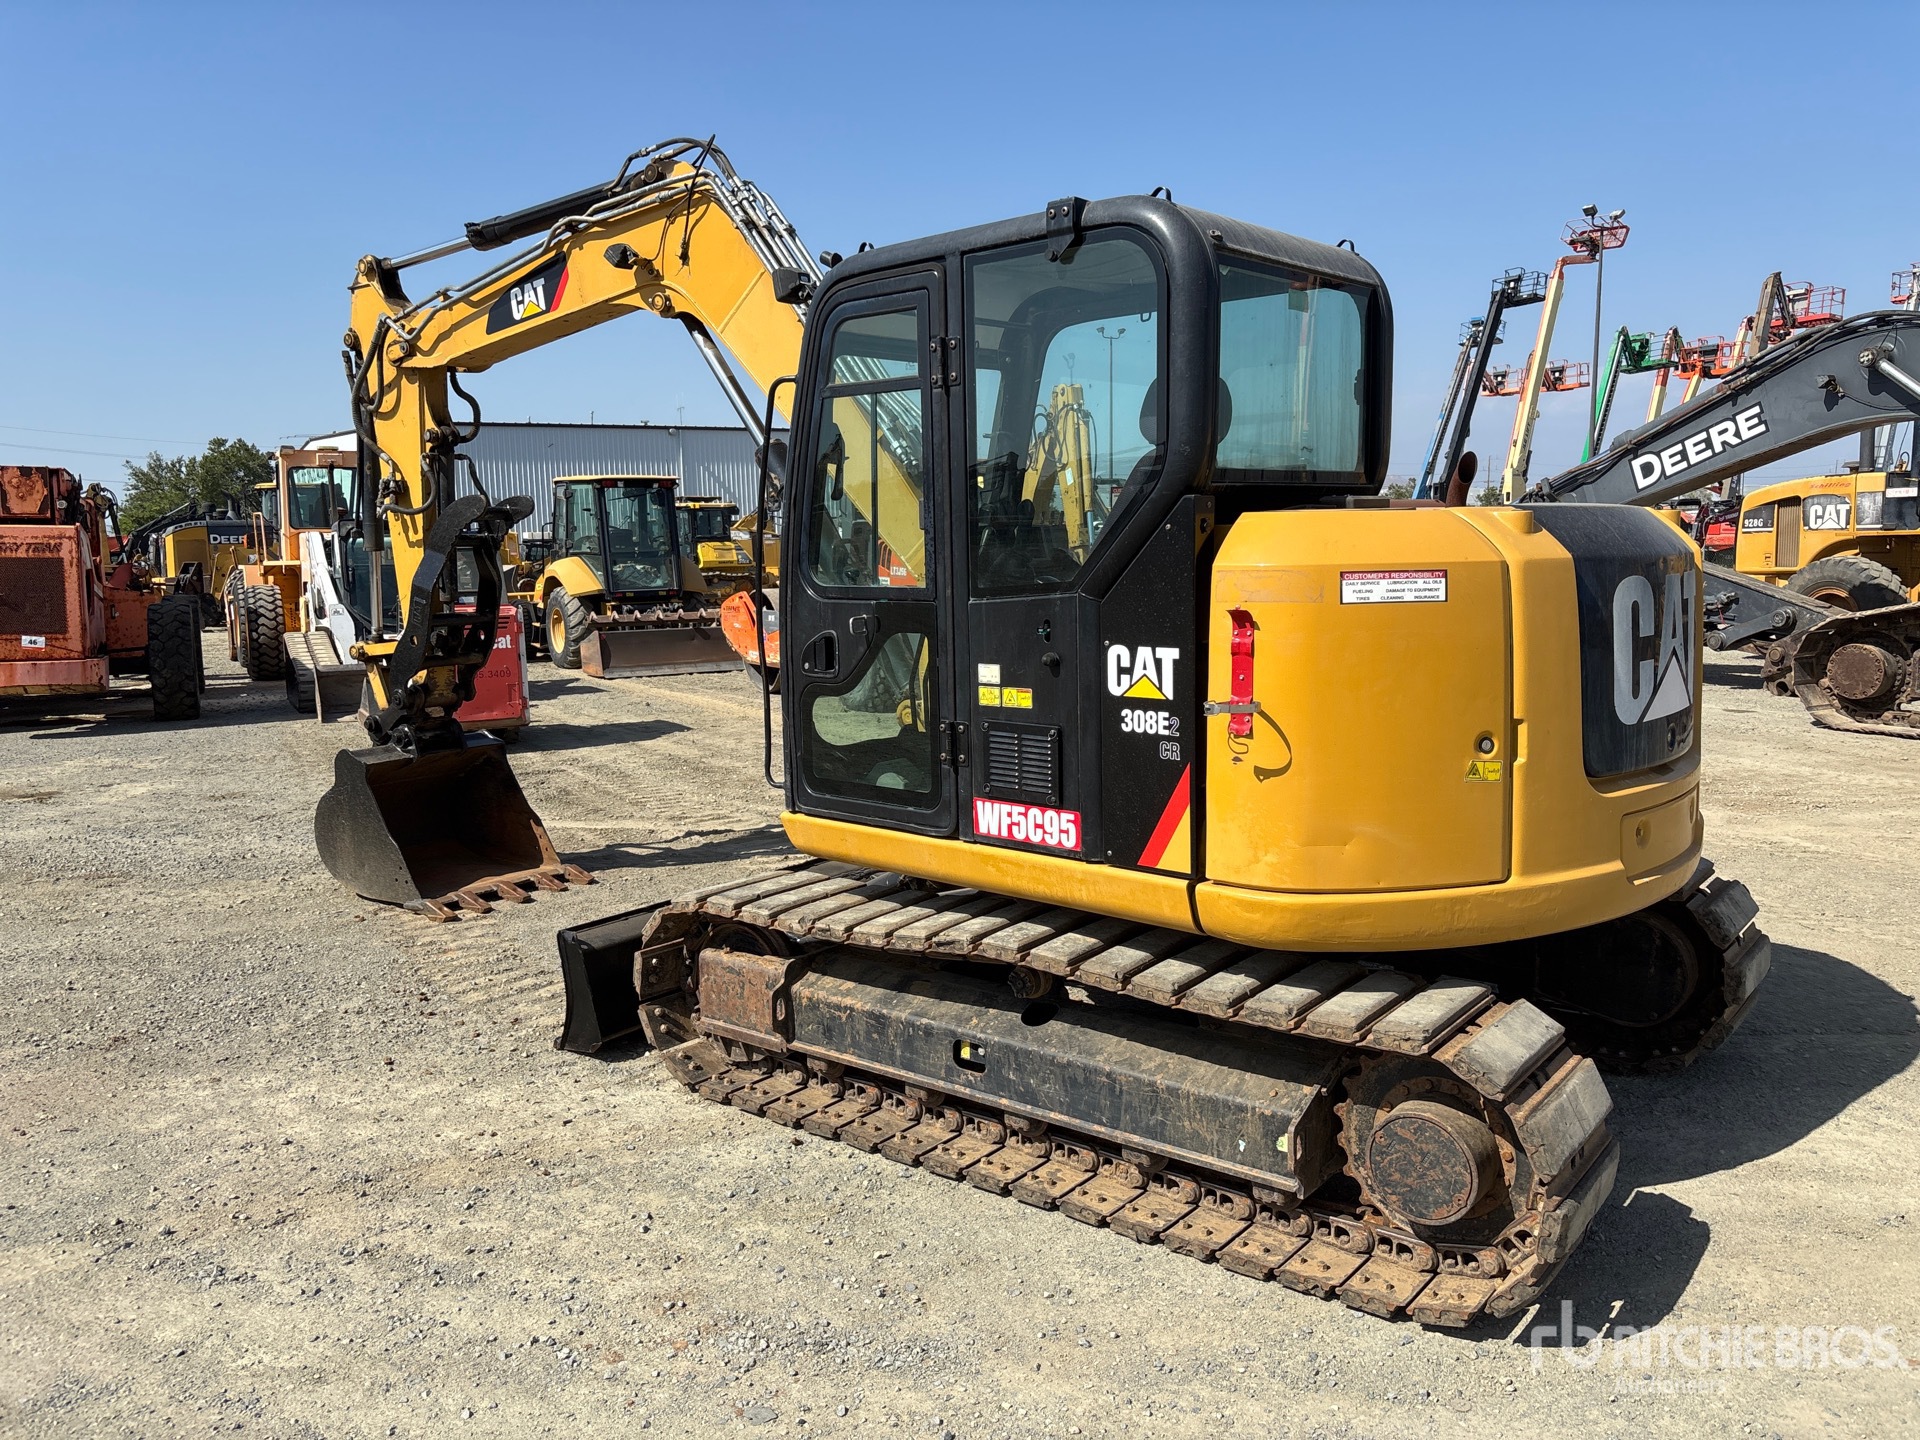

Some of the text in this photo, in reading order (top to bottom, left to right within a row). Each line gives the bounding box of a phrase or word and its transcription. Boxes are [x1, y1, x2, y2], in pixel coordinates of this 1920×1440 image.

[510, 277, 546, 320] CAT
[1631, 405, 1767, 490] DEERE
[1744, 518, 1764, 527] 928G
[1809, 504, 1850, 529] CAT
[1344, 571, 1444, 580] CUSTOMER'S RESPONSIBILITY
[1613, 570, 1696, 725] CAT
[1107, 644, 1180, 701] CAT
[1159, 741, 1181, 761] CR
[976, 800, 1077, 848] WF5C95
